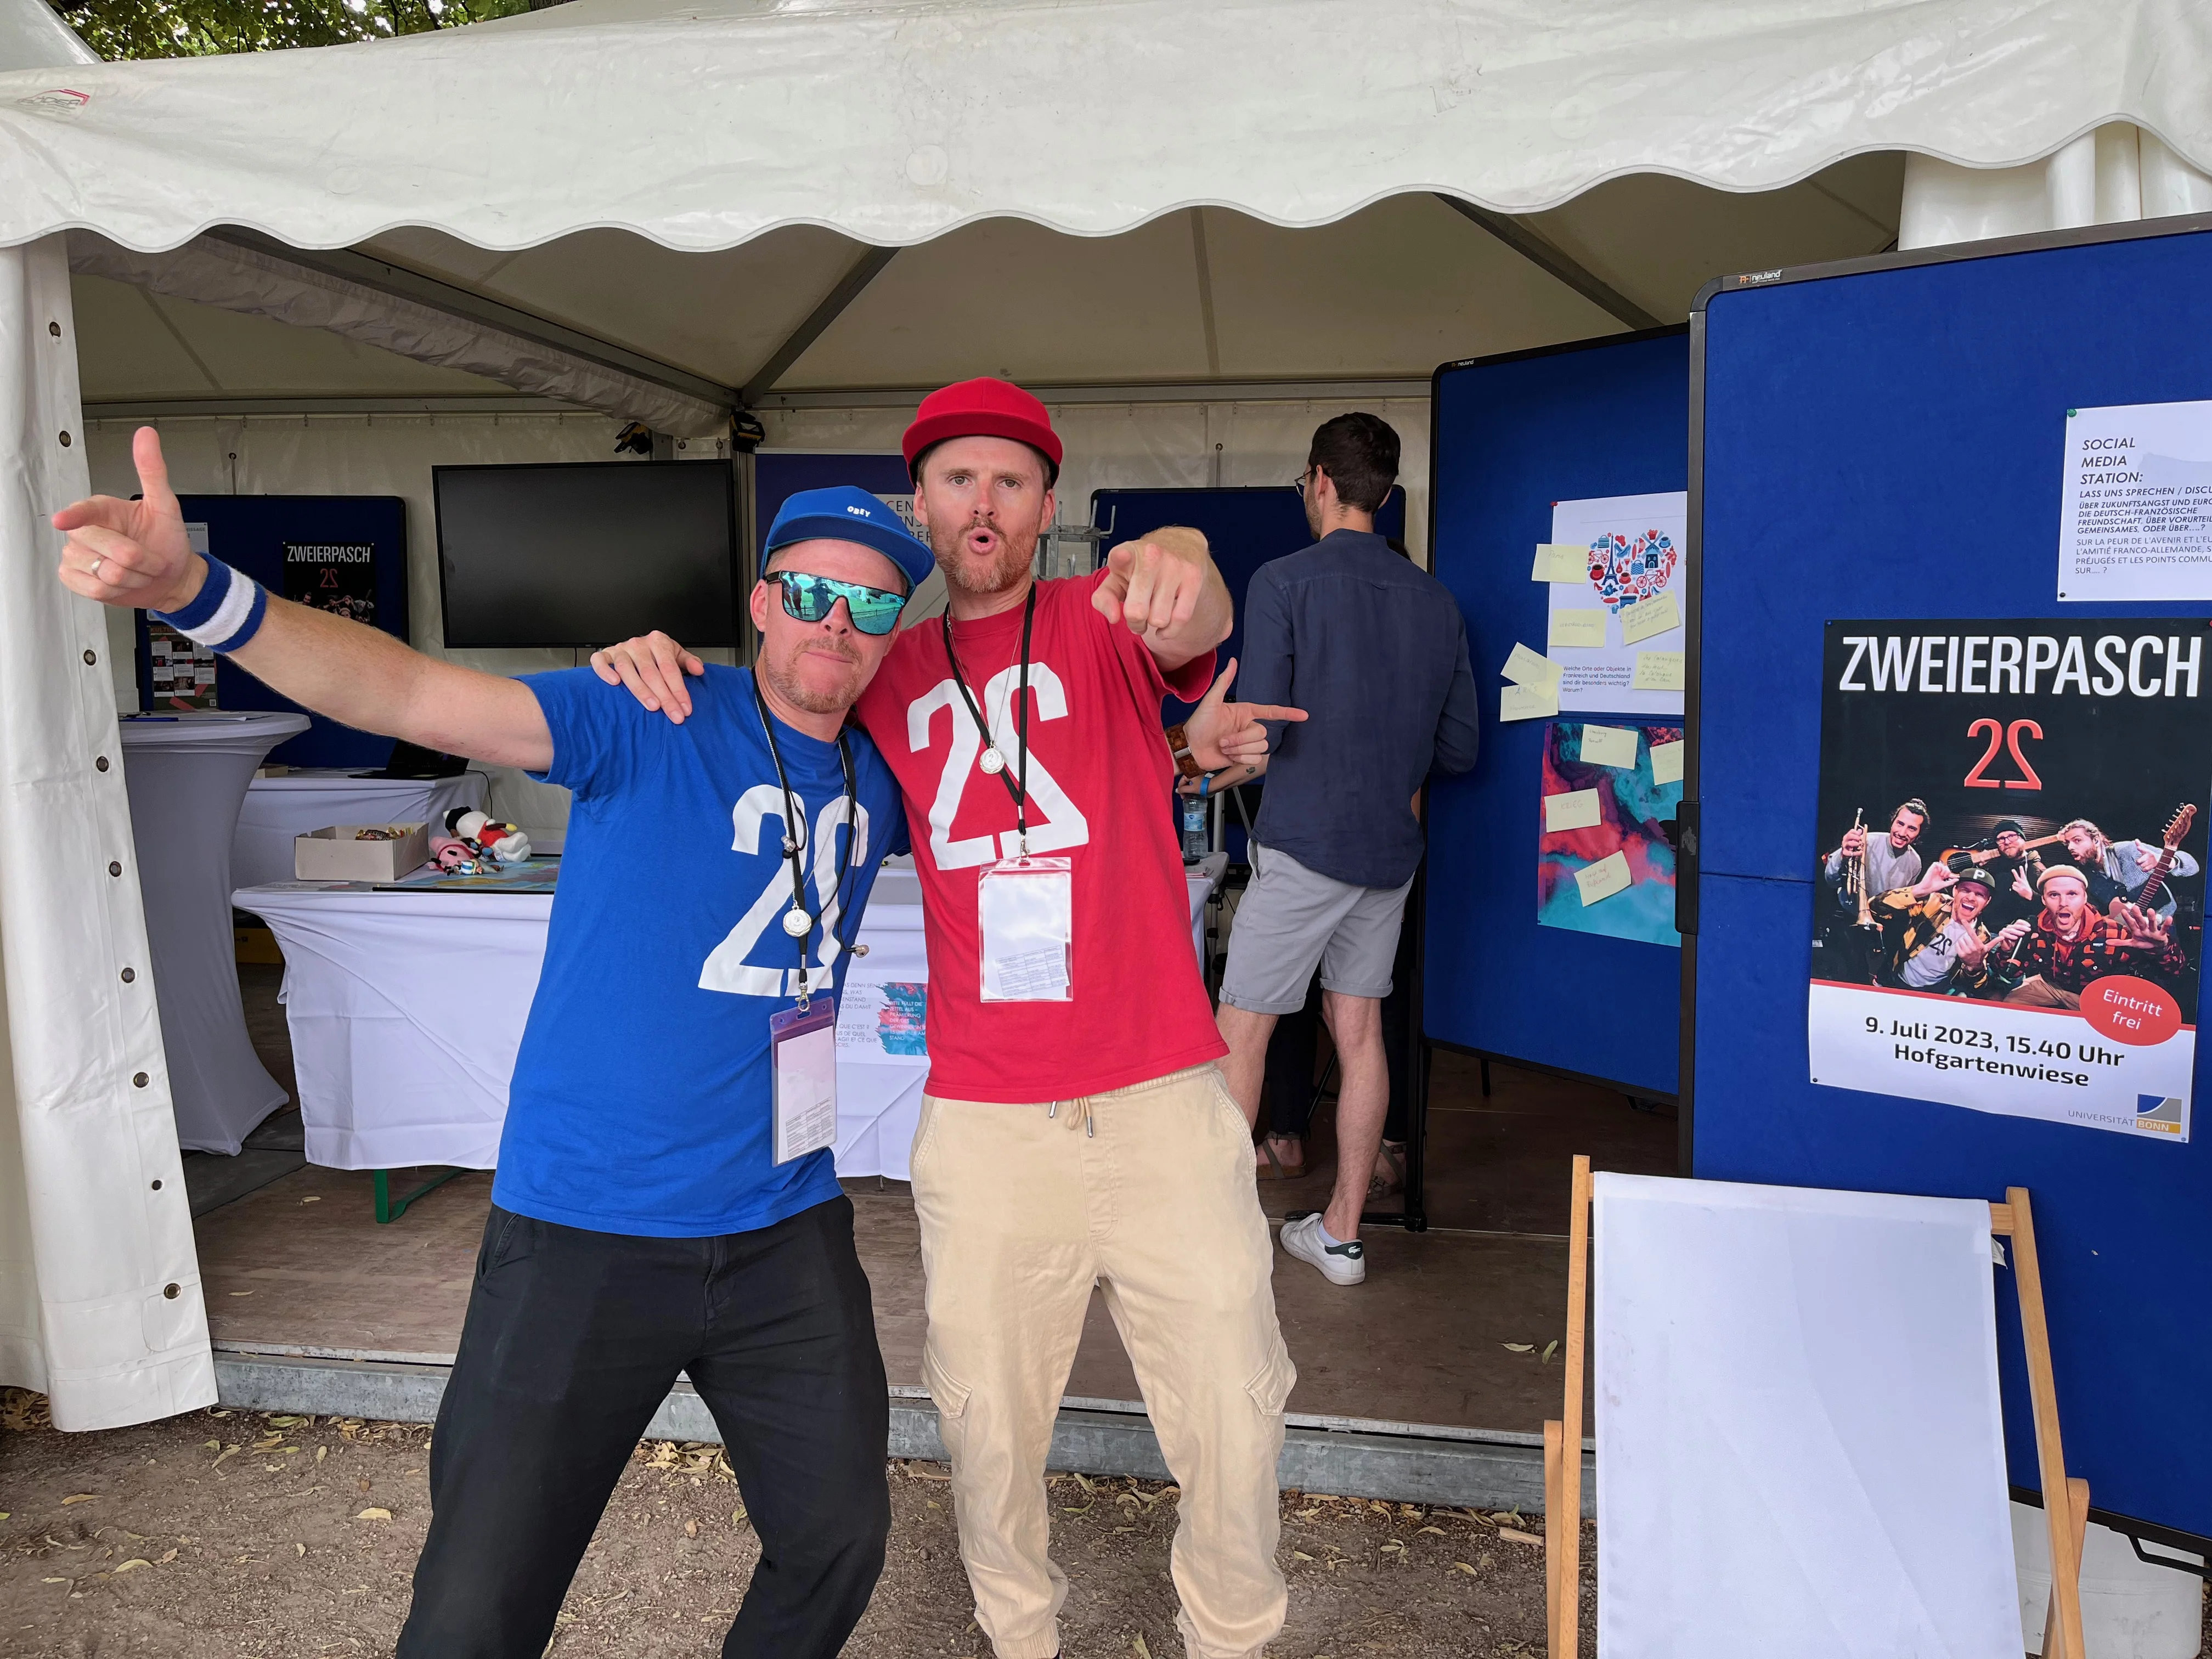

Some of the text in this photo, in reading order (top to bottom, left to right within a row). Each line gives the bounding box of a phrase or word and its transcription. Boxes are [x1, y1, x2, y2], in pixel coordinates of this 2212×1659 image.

[2082, 437, 2136, 450] SOCIAL
[2081, 455, 2127, 467] MEDIA
[2080, 472, 2143, 484] STATION:
[2125, 487, 2175, 496] SPRECHEN
[2101, 500, 2170, 509] ZUKUNFTSANGST
[847, 505, 871, 517] OBEY
[2094, 507, 2198, 517] DEUTSCH-FRANZÖSISCHE
[287, 546, 371, 563] ZWEIERPASCH
[2076, 546, 2111, 555] L'AMITIÉ
[2114, 546, 2204, 554] FRANCO-ALLEMANDE,
[2075, 556, 2116, 565] PRÉJUGÉS
[1839, 634, 2202, 697] ZWEIERPASCH
[1973, 869, 1985, 879] P
[2103, 989, 2163, 1018] Eintritt
[2112, 1011, 2142, 1030] frei
[1865, 1016, 2125, 1067] 9. Juli 2023, 15.40 Uhr
[1894, 1043, 2090, 1087] Hofgartenwiese
[2068, 1109, 2169, 1132] UNIVERSITÄT BONN
